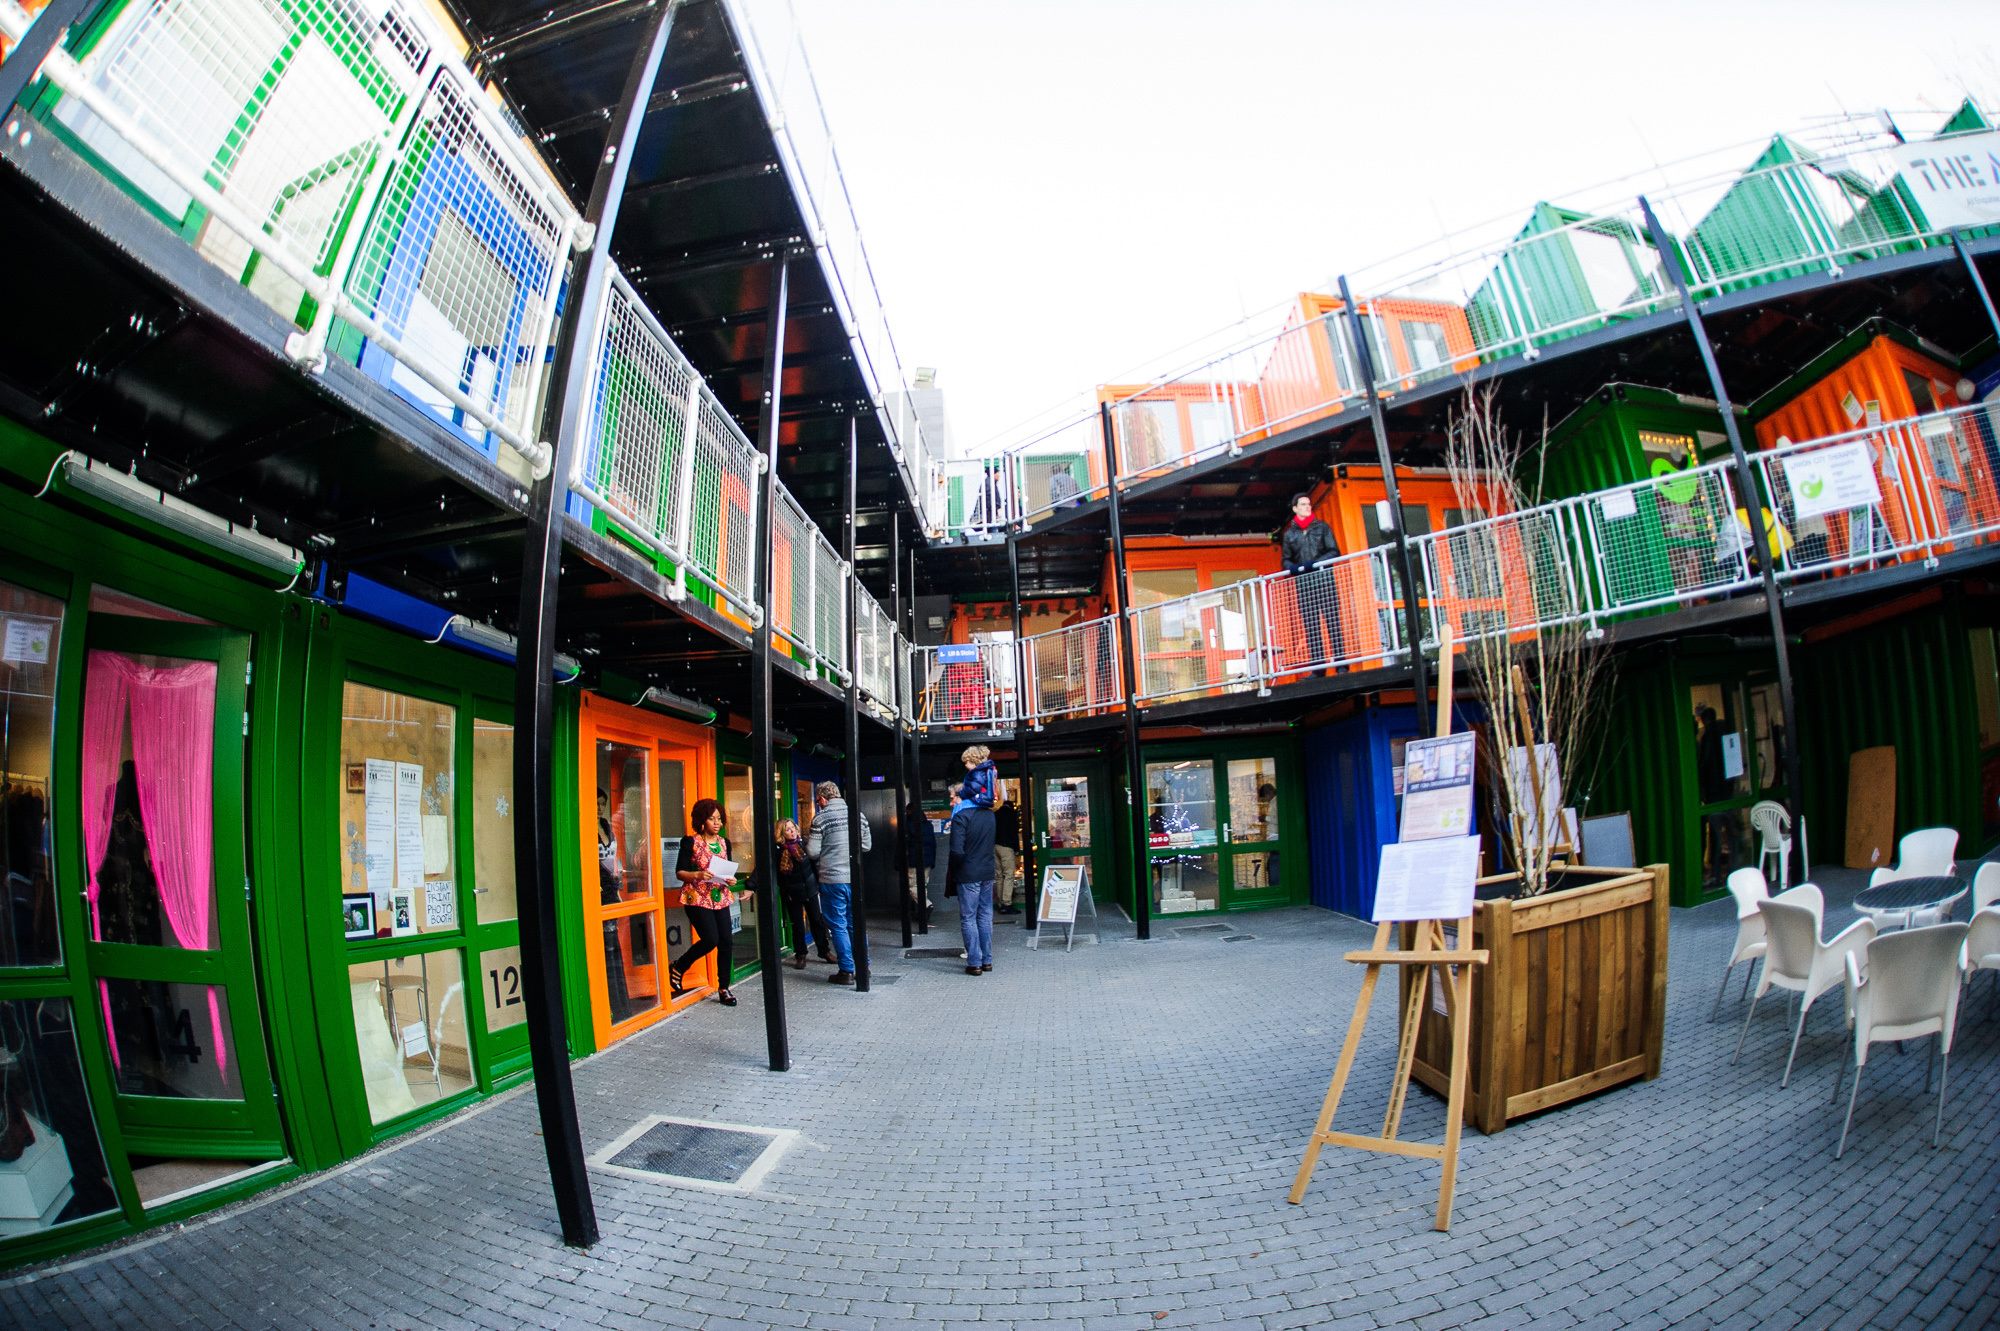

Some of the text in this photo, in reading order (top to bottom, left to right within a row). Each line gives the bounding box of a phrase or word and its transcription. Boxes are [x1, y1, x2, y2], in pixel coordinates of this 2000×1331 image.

[1909, 154, 1986, 192] THE
[1054, 886, 1076, 895] TODAY
[428, 892, 451, 904] PRINT
[427, 903, 453, 915] PHOTO
[431, 913, 452, 925] BOOTH
[490, 965, 525, 1009] 12
